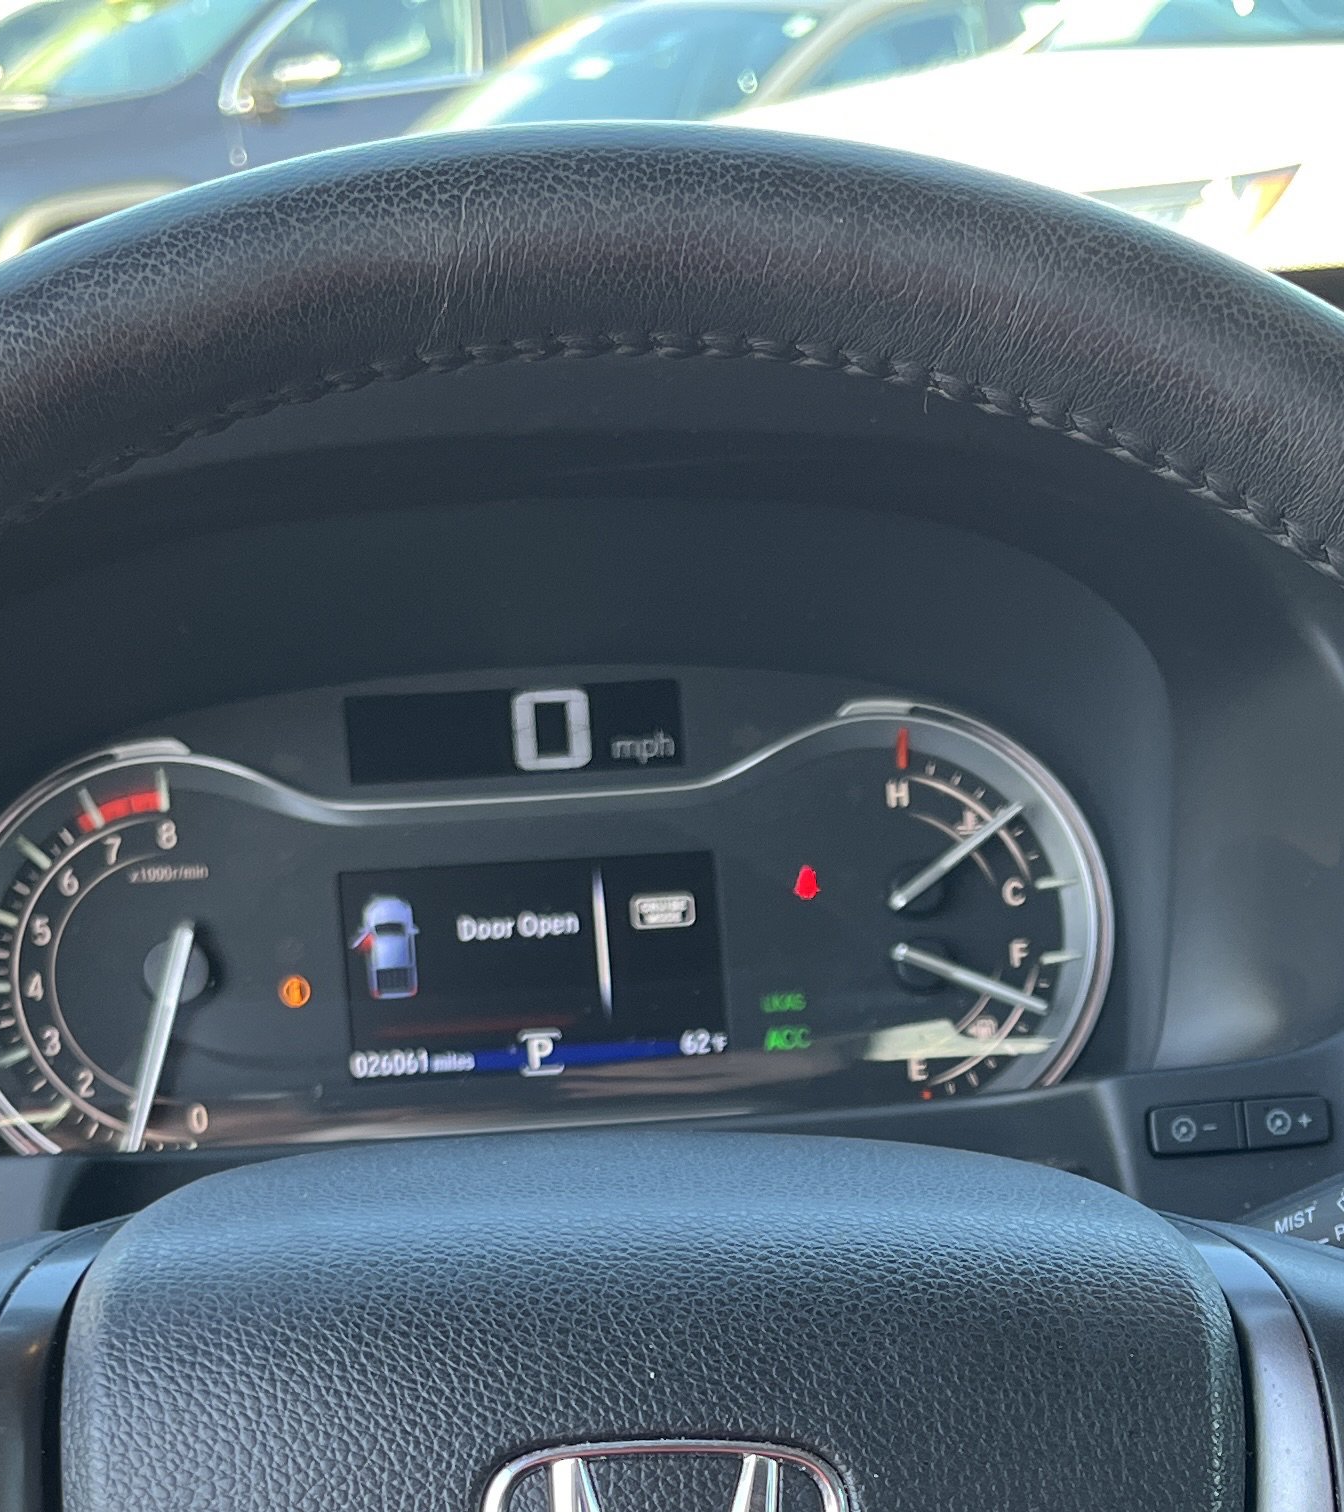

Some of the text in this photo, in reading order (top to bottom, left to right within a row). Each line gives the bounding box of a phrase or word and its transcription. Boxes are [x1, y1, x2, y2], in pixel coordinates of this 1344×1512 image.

[609, 730, 676, 765] mph
[885, 778, 910, 809] H
[101, 835, 121, 865] 7
[157, 819, 177, 850] 8
[57, 868, 79, 897] 6
[1002, 877, 1026, 907] C
[32, 916, 51, 947] 5
[457, 910, 580, 943] Door Open
[1009, 938, 1029, 969] F
[25, 971, 44, 1001] 4
[764, 1025, 812, 1052] ACC
[75, 1066, 96, 1099] 2
[1274, 1205, 1317, 1236] MIST
